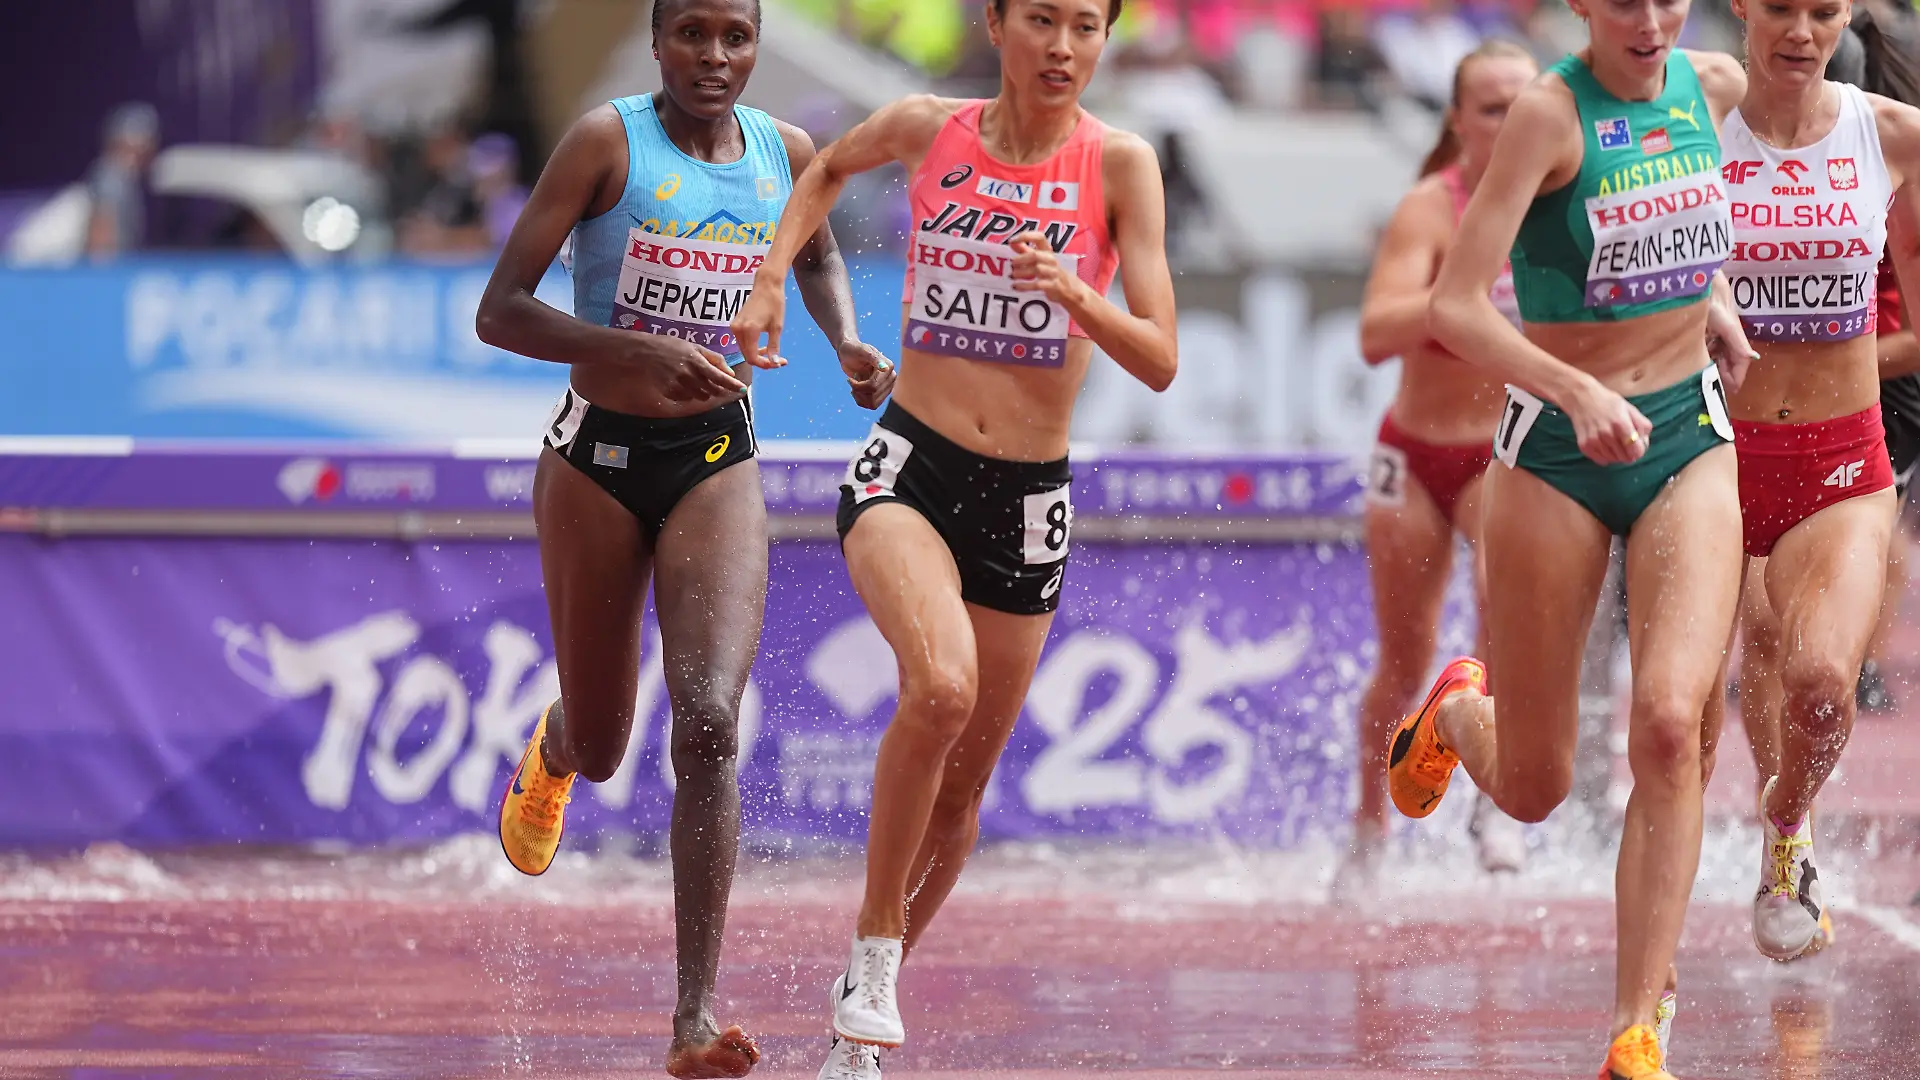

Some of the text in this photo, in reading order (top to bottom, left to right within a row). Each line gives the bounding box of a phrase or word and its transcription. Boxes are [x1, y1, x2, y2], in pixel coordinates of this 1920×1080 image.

[981, 181, 1030, 200] ACN
[1599, 153, 1715, 199] AUSTRALIA
[1771, 186, 1815, 196] ORLEN
[1593, 183, 1725, 230] HONDA
[1731, 202, 1858, 228] POLSKA
[920, 201, 1077, 254] JAPAN
[1596, 219, 1729, 274] FEAIN-RYAN
[628, 239, 766, 274] HONDA
[917, 244, 1013, 277] HON
[1728, 238, 1872, 262] HONDA
[924, 284, 1051, 333] SAITO
[1729, 271, 1868, 309] ONIECZEK
[854, 438, 889, 483] 8
[1824, 460, 1865, 488] 4F
[1045, 500, 1067, 551] 8
[1020, 605, 1310, 824] 25
